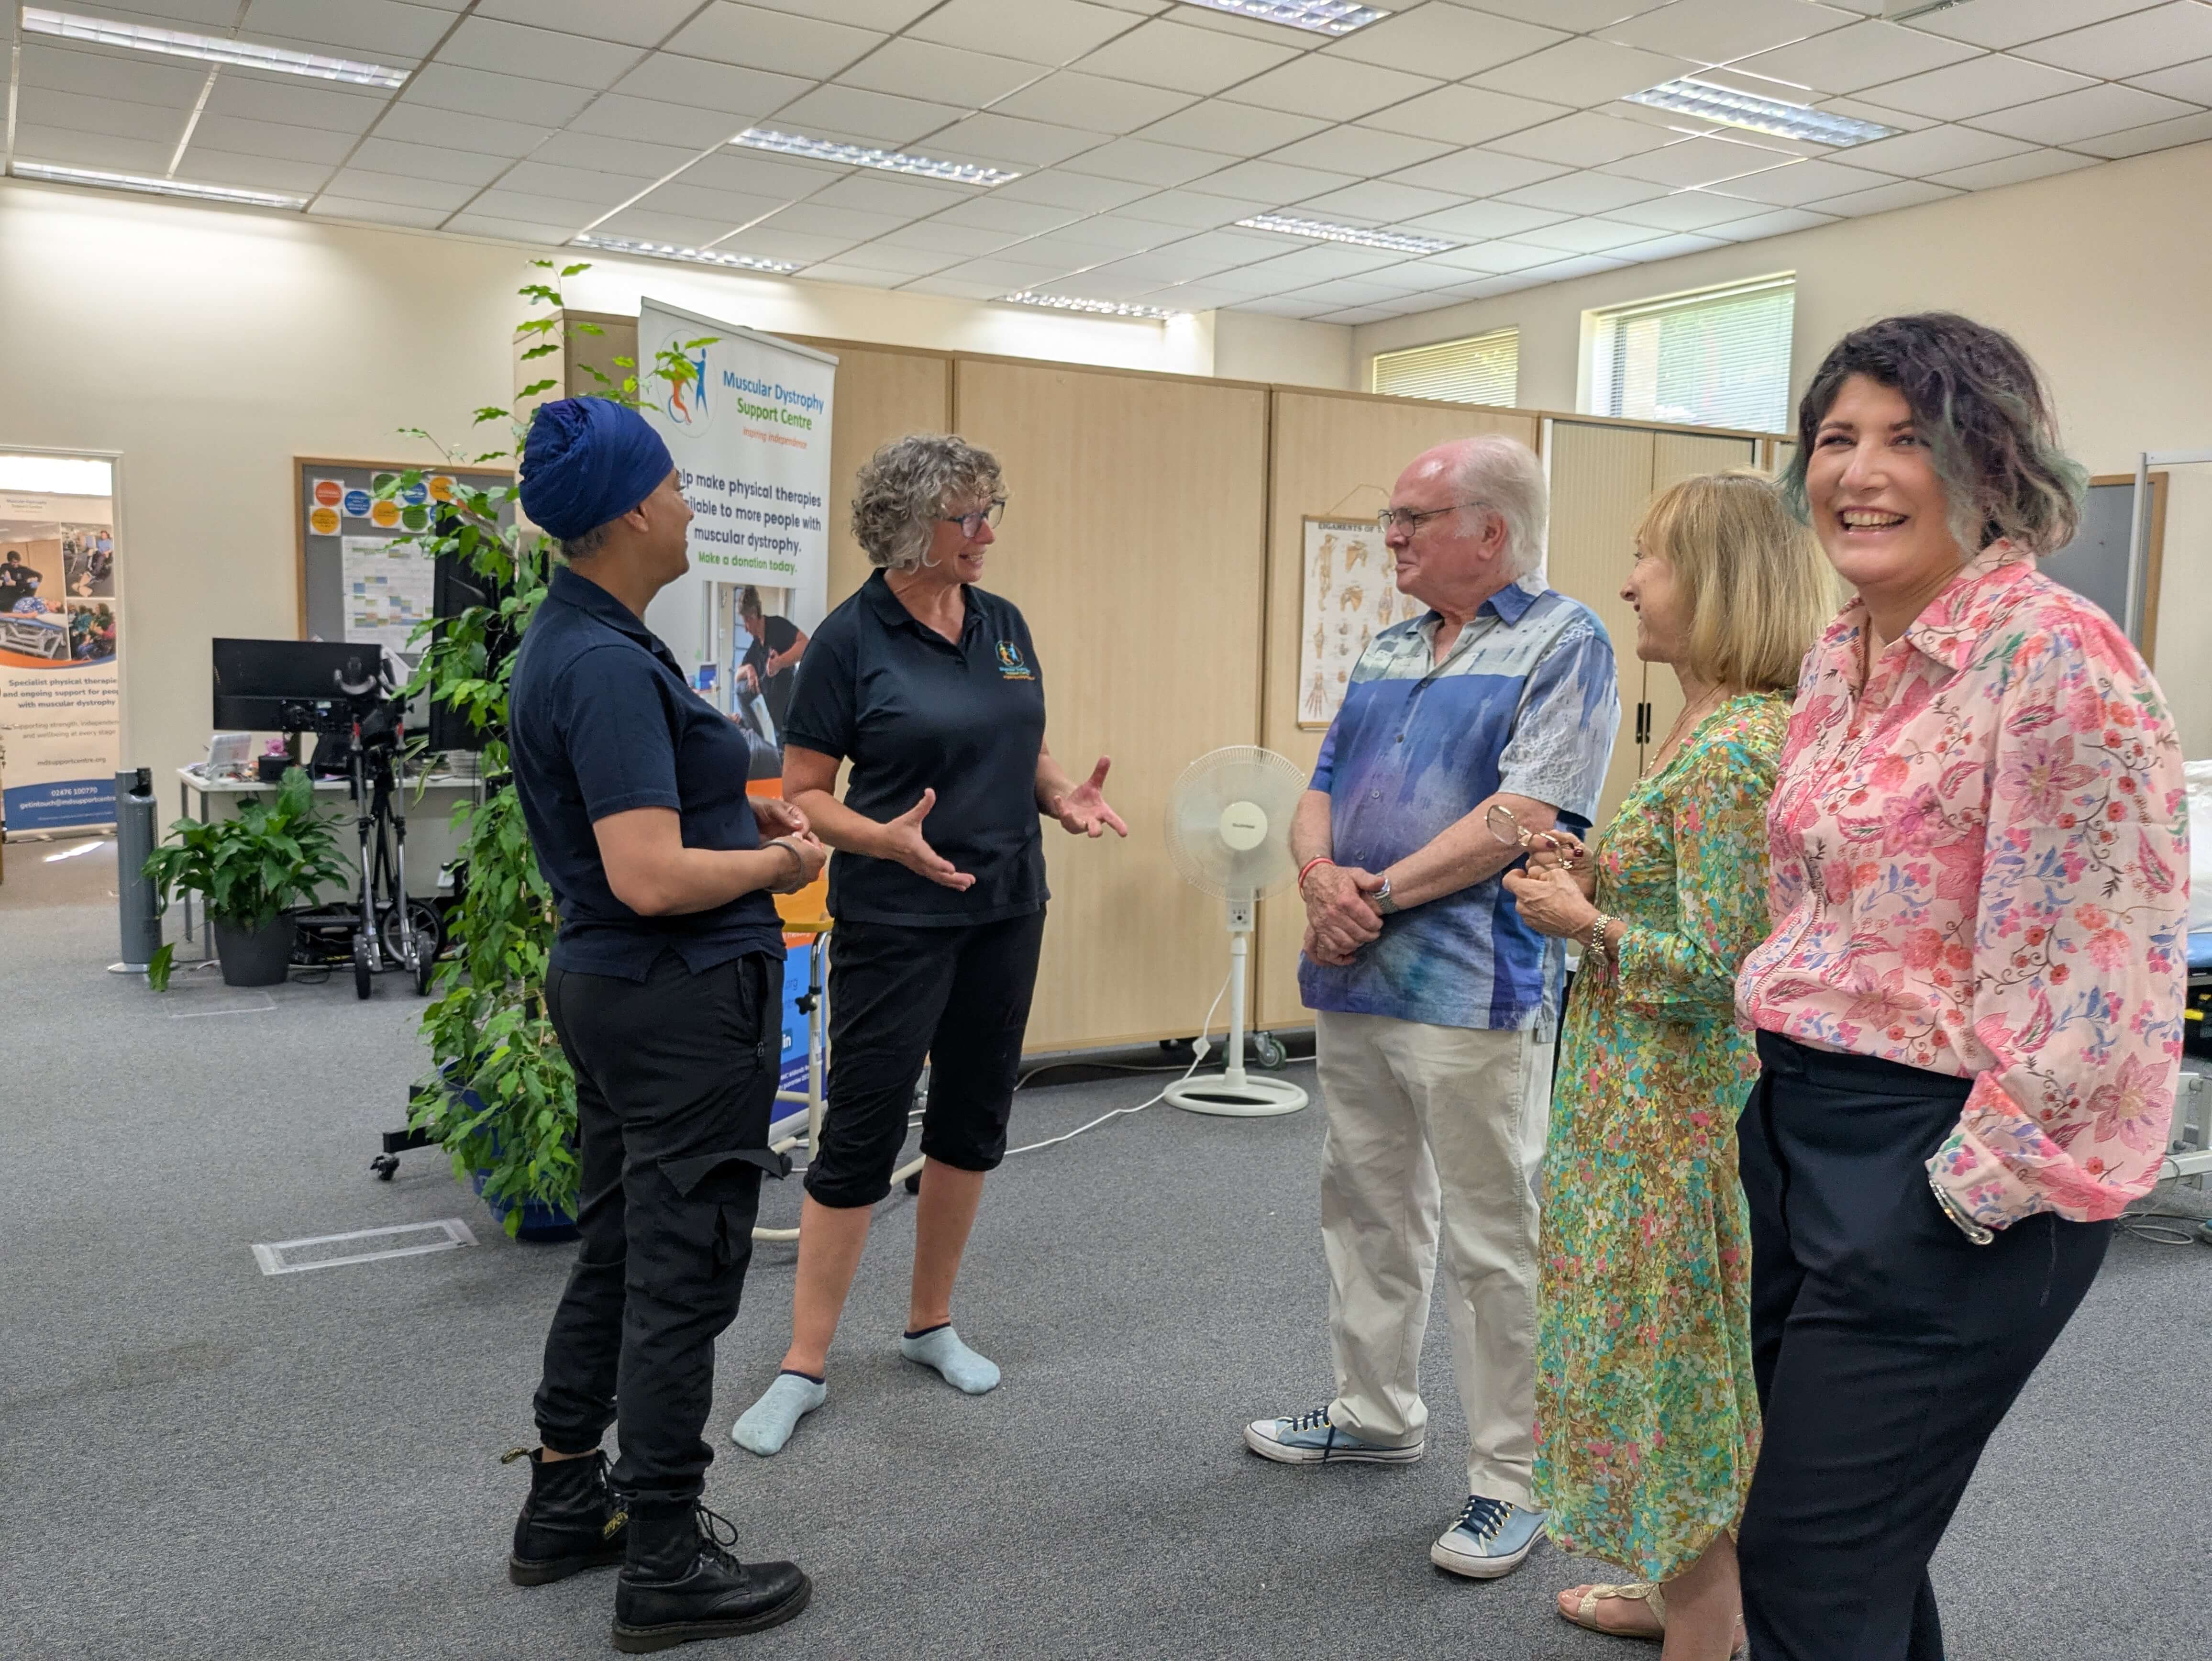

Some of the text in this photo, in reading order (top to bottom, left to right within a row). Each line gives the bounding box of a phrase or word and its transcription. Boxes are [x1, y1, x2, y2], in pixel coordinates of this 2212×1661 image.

[723, 370, 824, 415] Muscular Dystrophy
[737, 398, 812, 430] Support Centre
[696, 474, 725, 491] make
[729, 479, 772, 499] physical
[776, 487, 821, 509] therapies
[720, 503, 732, 518] to
[736, 507, 762, 522] more
[765, 512, 800, 531] people
[803, 516, 821, 532] with
[695, 527, 801, 556] muscular dystrophy.
[698, 552, 797, 576] Make a donation today.
[21, 689, 53, 698] ongoing
[50, 678, 81, 686] physical
[77, 699, 115, 707] dystrophy
